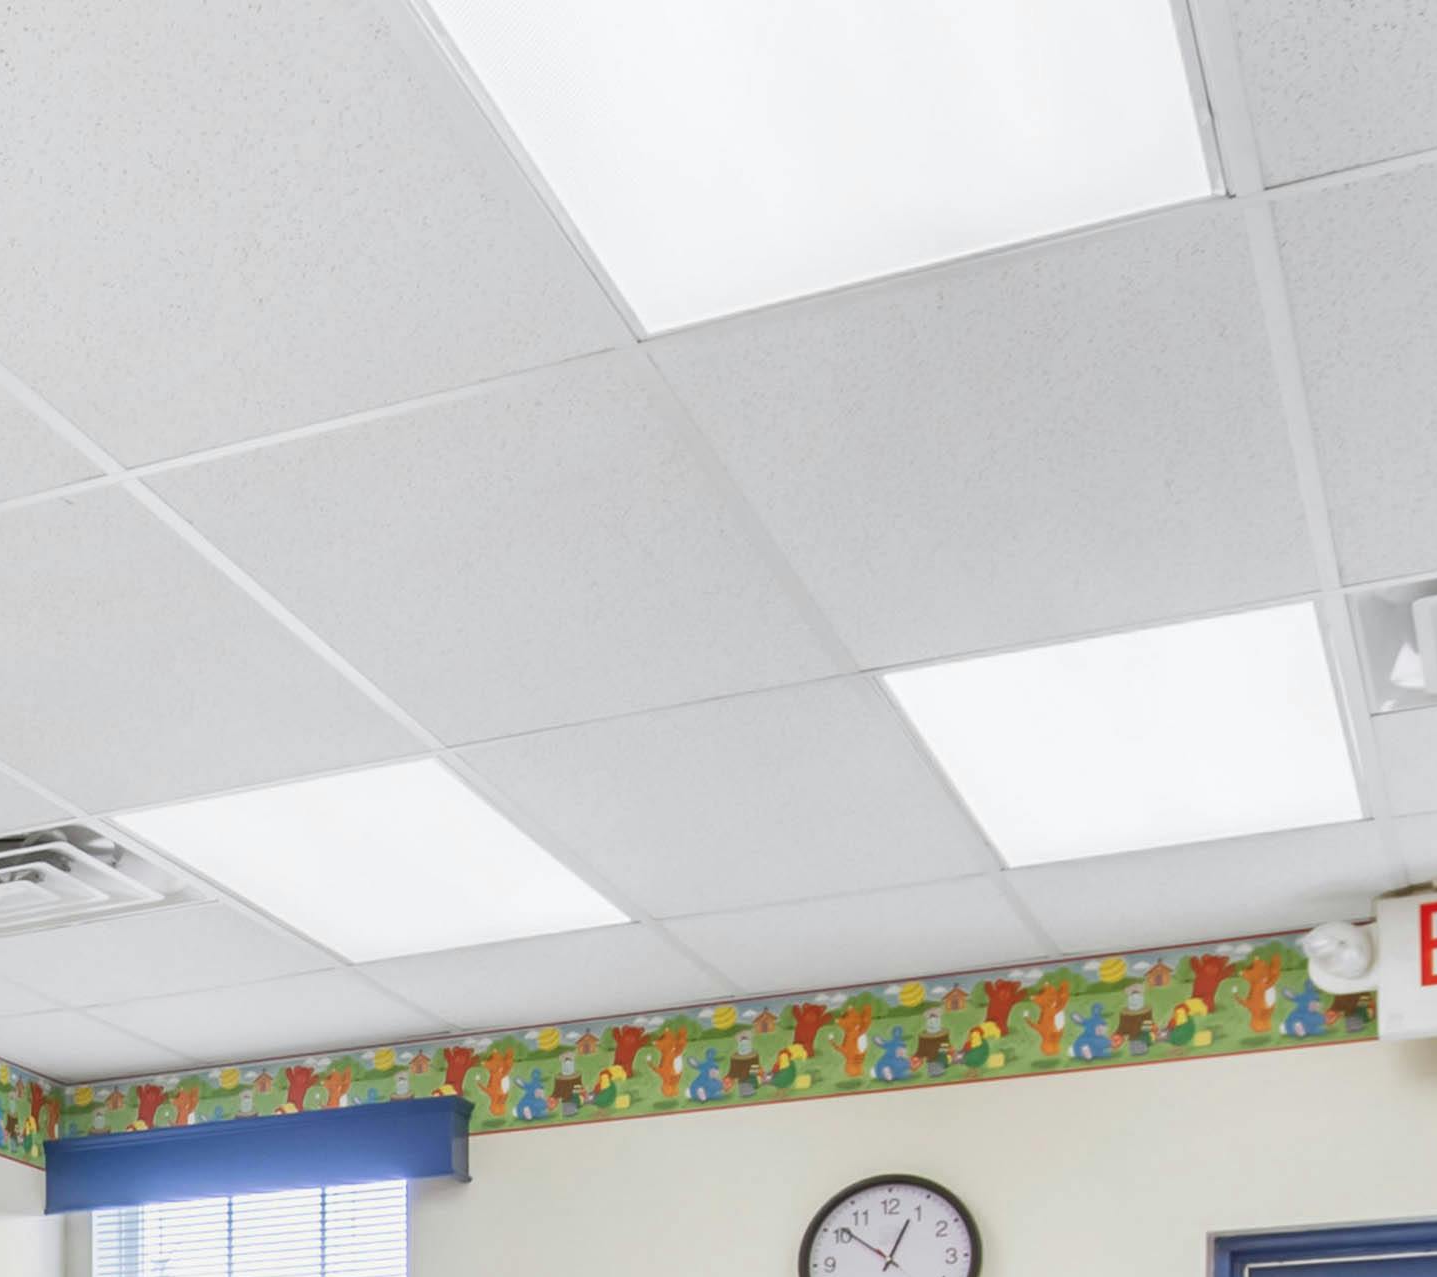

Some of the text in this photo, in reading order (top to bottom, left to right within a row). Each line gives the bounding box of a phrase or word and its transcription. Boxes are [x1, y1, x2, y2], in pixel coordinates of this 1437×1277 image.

[880, 1198, 901, 1215] 12
[914, 1205, 922, 1221] 1
[852, 1210, 869, 1226] 11
[833, 1227, 853, 1244] 10
[935, 1220, 948, 1238] 2
[824, 1256, 837, 1273] 9
[945, 1248, 958, 1265] 3
